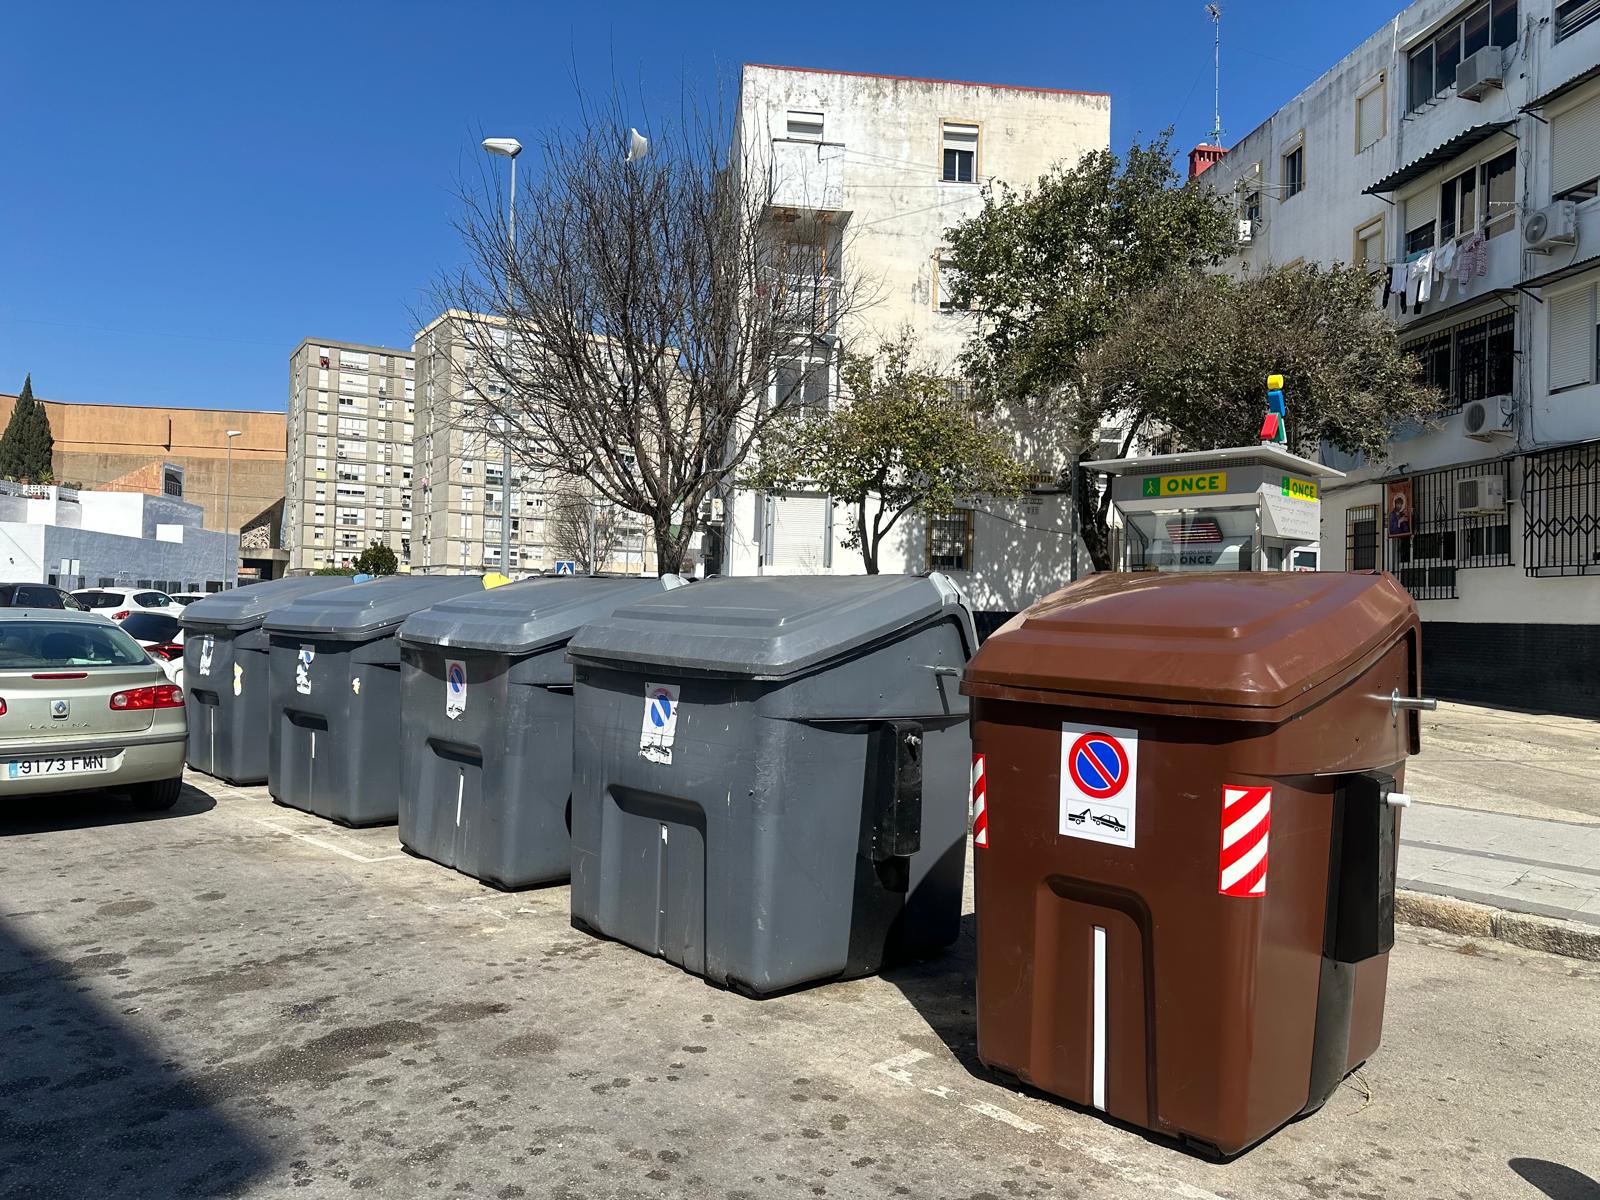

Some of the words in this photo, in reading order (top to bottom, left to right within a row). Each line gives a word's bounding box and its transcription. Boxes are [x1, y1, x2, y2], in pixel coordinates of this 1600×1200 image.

[1167, 475, 1219, 492] ONCE
[1292, 481, 1315, 499] ONCE
[1180, 555, 1212, 565] ONCE
[22, 758, 66, 774] 9173
[72, 755, 104, 770] FMN
